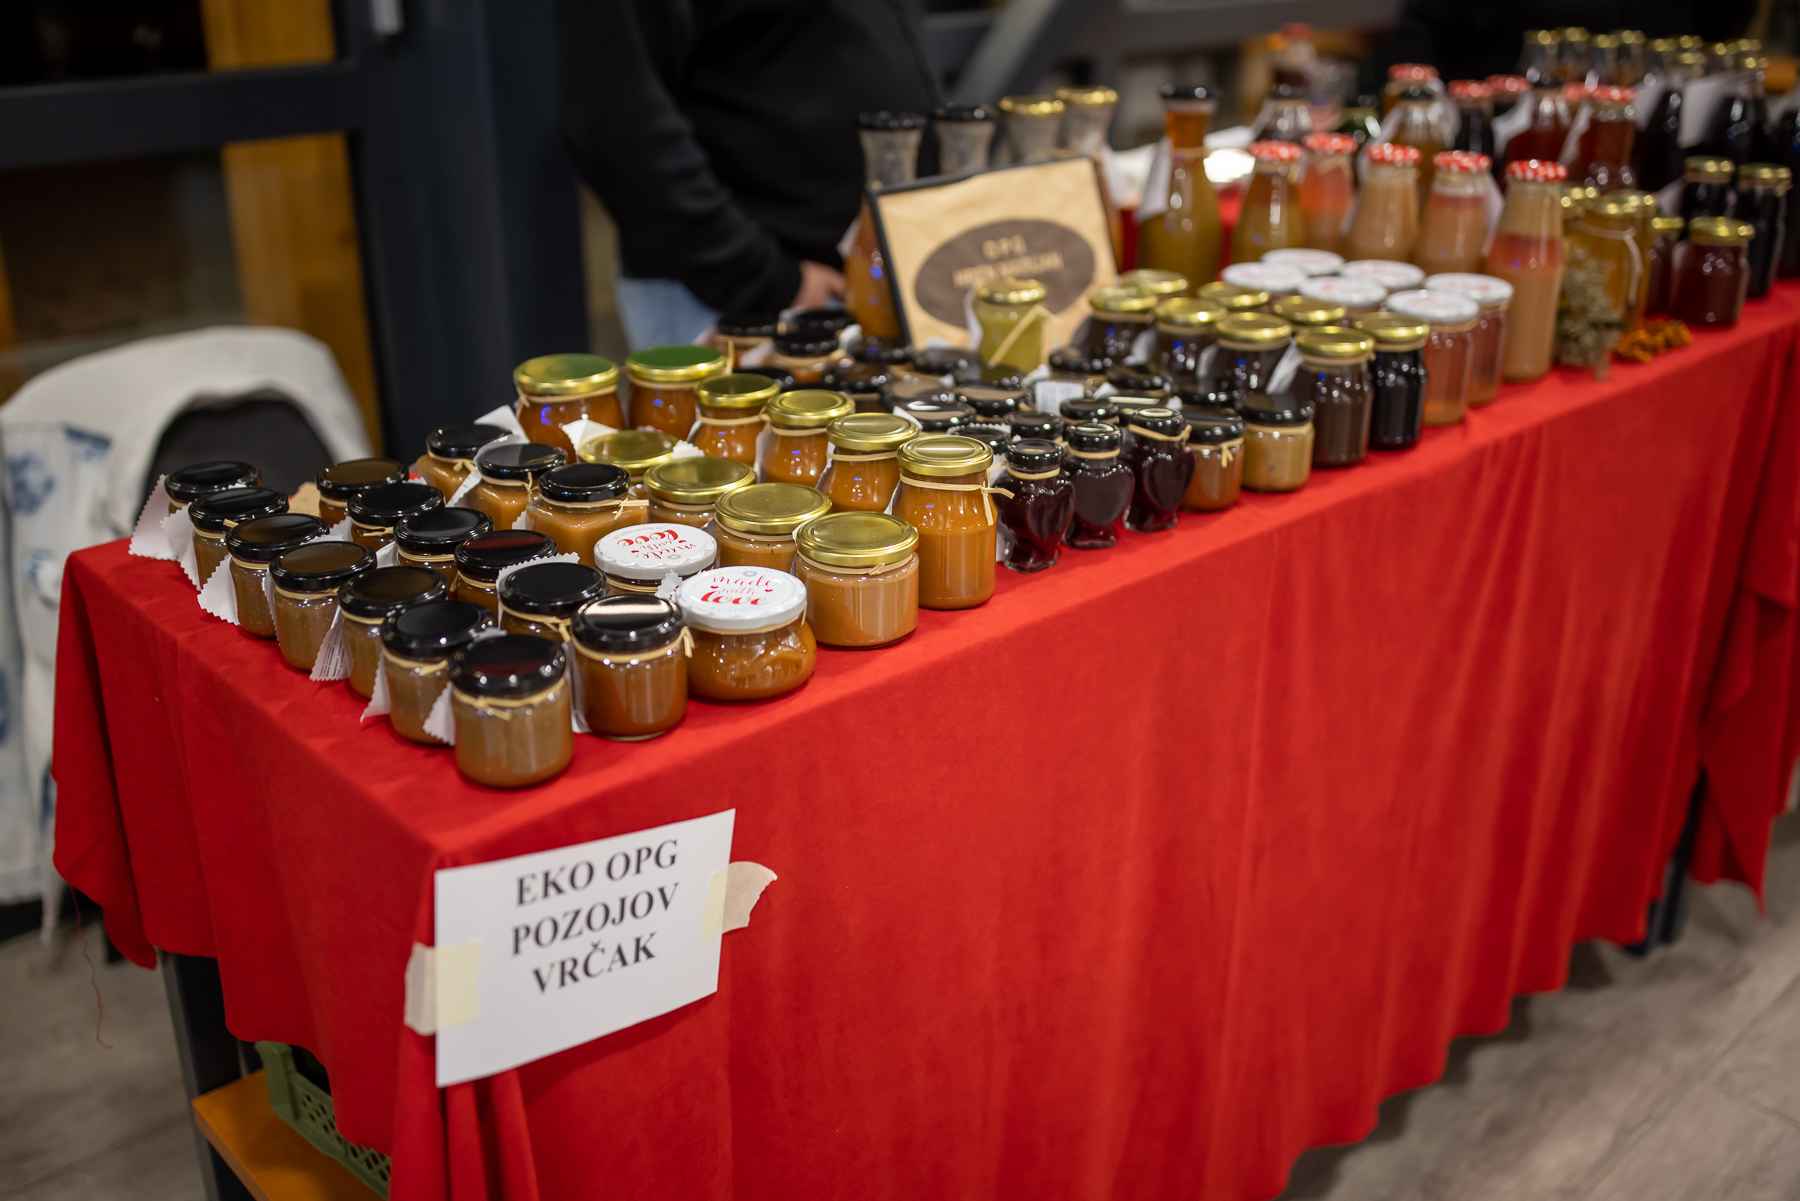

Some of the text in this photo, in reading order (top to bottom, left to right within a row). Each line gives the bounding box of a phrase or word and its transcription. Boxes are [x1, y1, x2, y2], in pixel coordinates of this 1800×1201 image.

[516, 839, 678, 906] EKO OPG
[512, 882, 679, 956] POZOJOV
[532, 932, 656, 993] VRČAK
